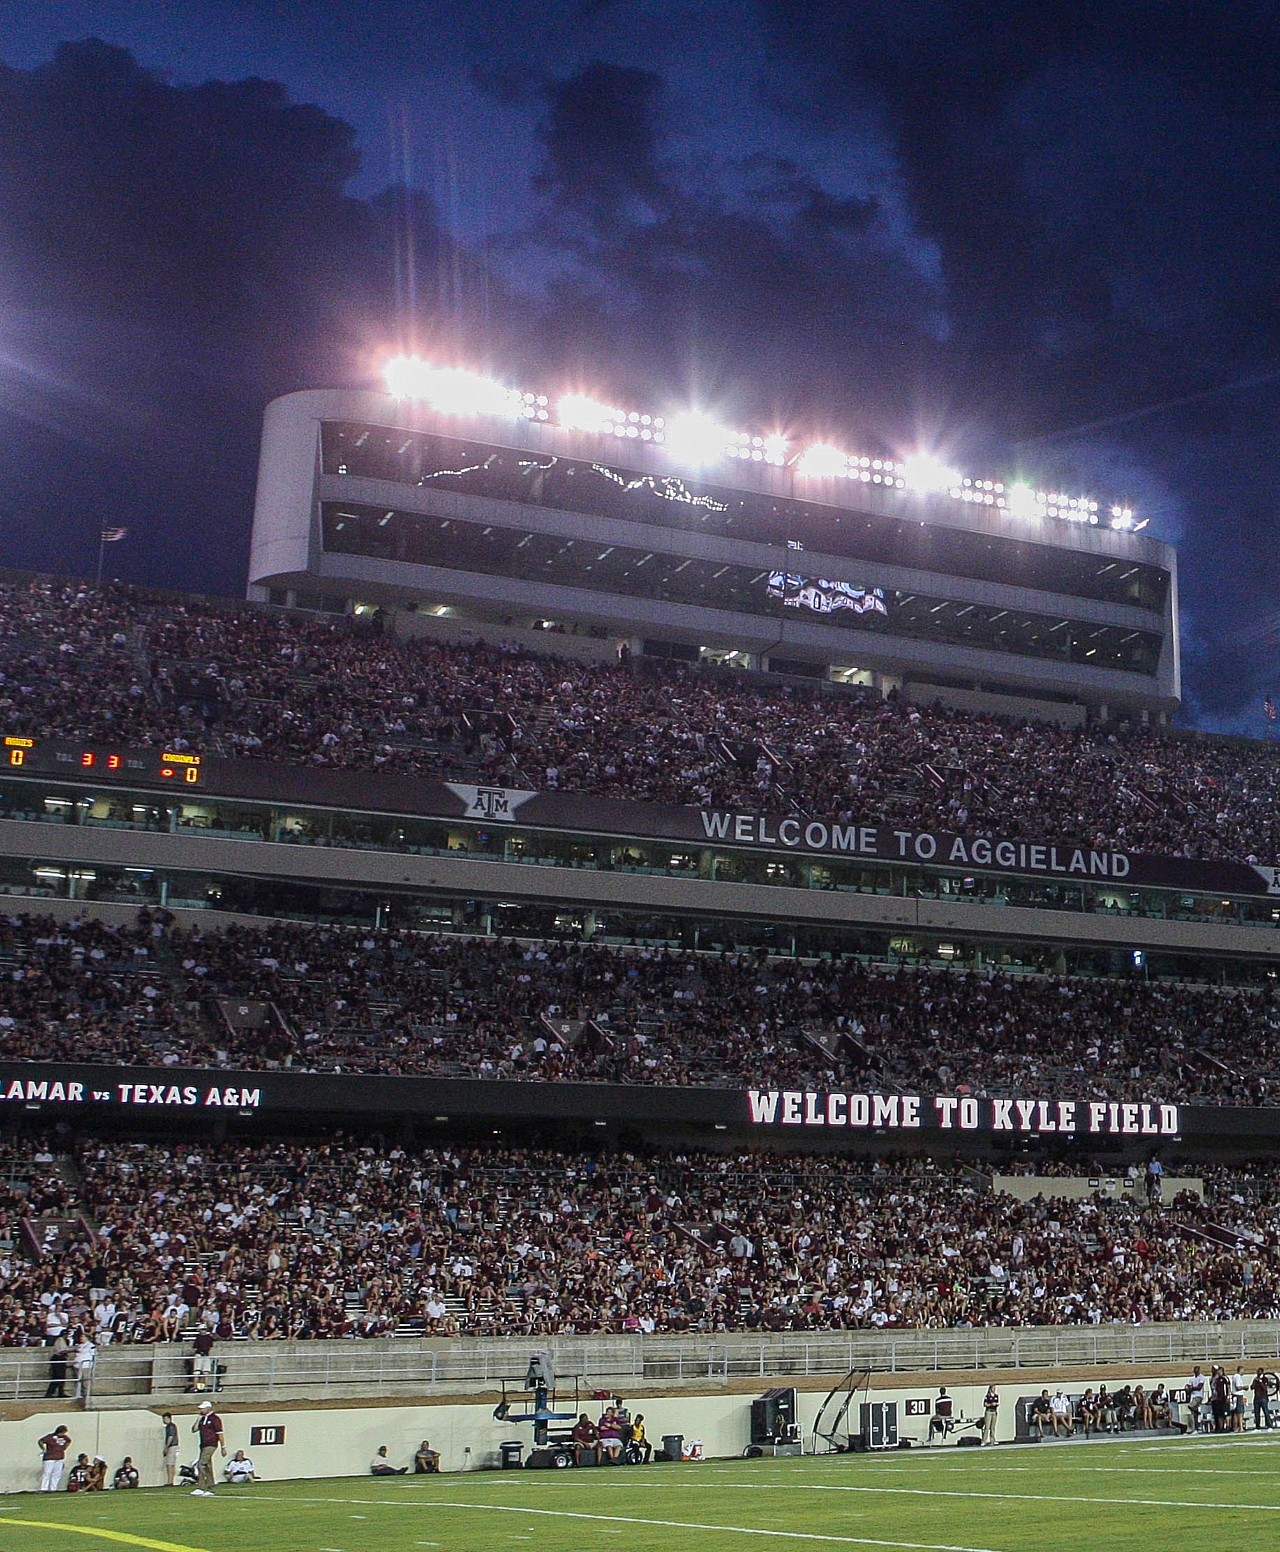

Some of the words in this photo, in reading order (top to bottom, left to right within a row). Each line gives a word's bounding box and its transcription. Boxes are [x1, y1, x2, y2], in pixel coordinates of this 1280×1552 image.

[10, 750, 24, 766] 0
[82, 753, 93, 765] 3
[109, 755, 119, 768] 3
[186, 767, 198, 783] 0
[700, 811, 878, 853] WELCOME
[893, 830, 937, 859] TO
[949, 837, 1130, 877] AGGIELAND
[93, 1089, 110, 1100] vs
[118, 1083, 198, 1105] TEXAS
[205, 1087, 261, 1107] A&M
[748, 1090, 920, 1128] WELCOME
[936, 1097, 979, 1129] TO
[993, 1099, 1077, 1131] KYLE
[1090, 1102, 1178, 1134] FIELD
[1174, 1390, 1187, 1402] 40
[910, 1400, 926, 1414] 30
[259, 1427, 276, 1444] 10
